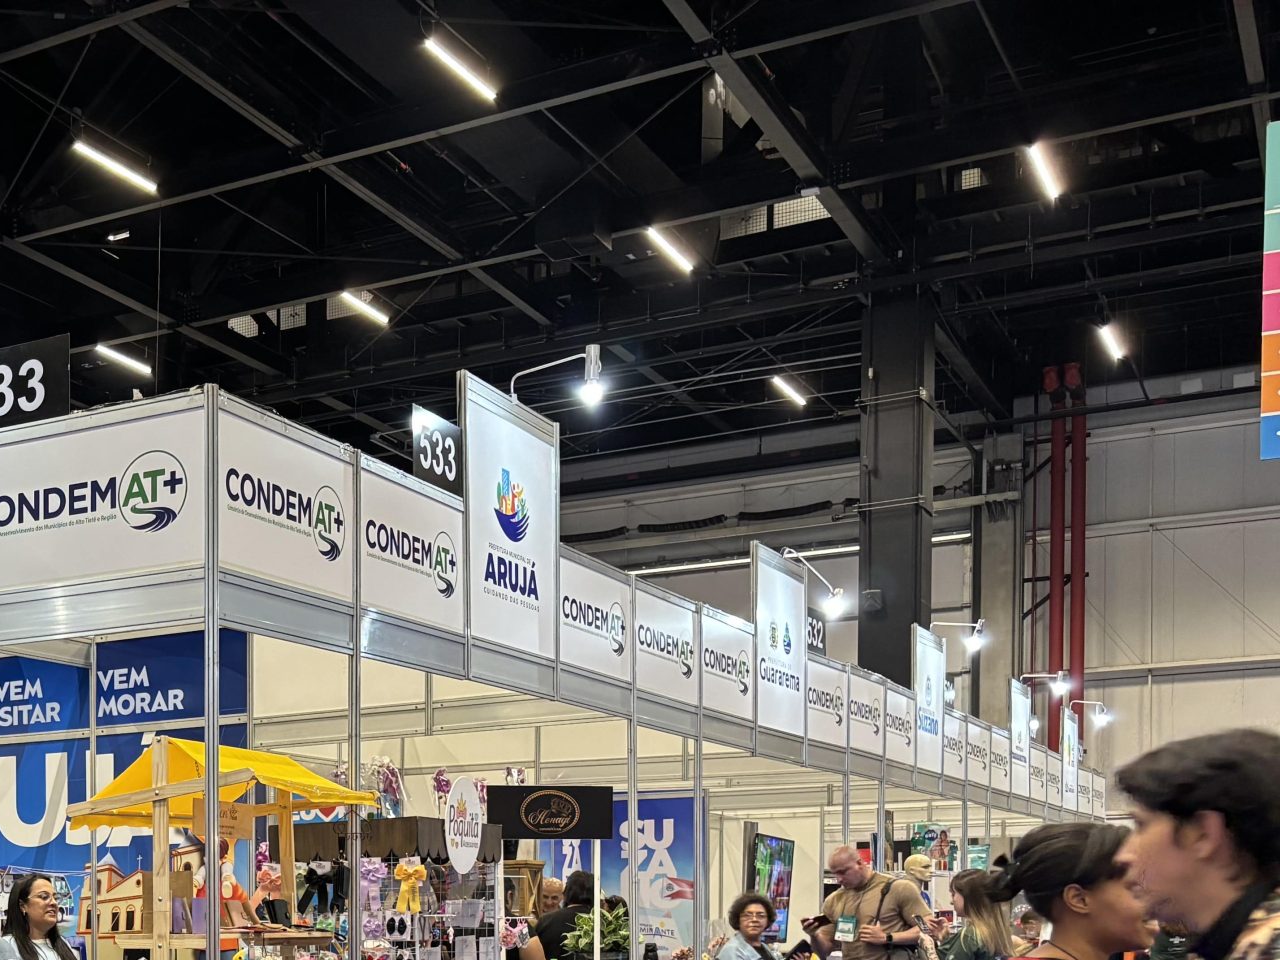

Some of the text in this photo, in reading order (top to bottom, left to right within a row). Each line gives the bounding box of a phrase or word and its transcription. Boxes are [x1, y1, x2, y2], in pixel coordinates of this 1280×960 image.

[419, 426, 458, 483] 533
[484, 552, 539, 602] ARUJÁ
[807, 618, 824, 649] 532
[97, 665, 149, 691] VEM
[759, 657, 800, 692] Guararema
[97, 688, 184, 719] MORAR
[639, 927, 675, 937] MIRANTE
